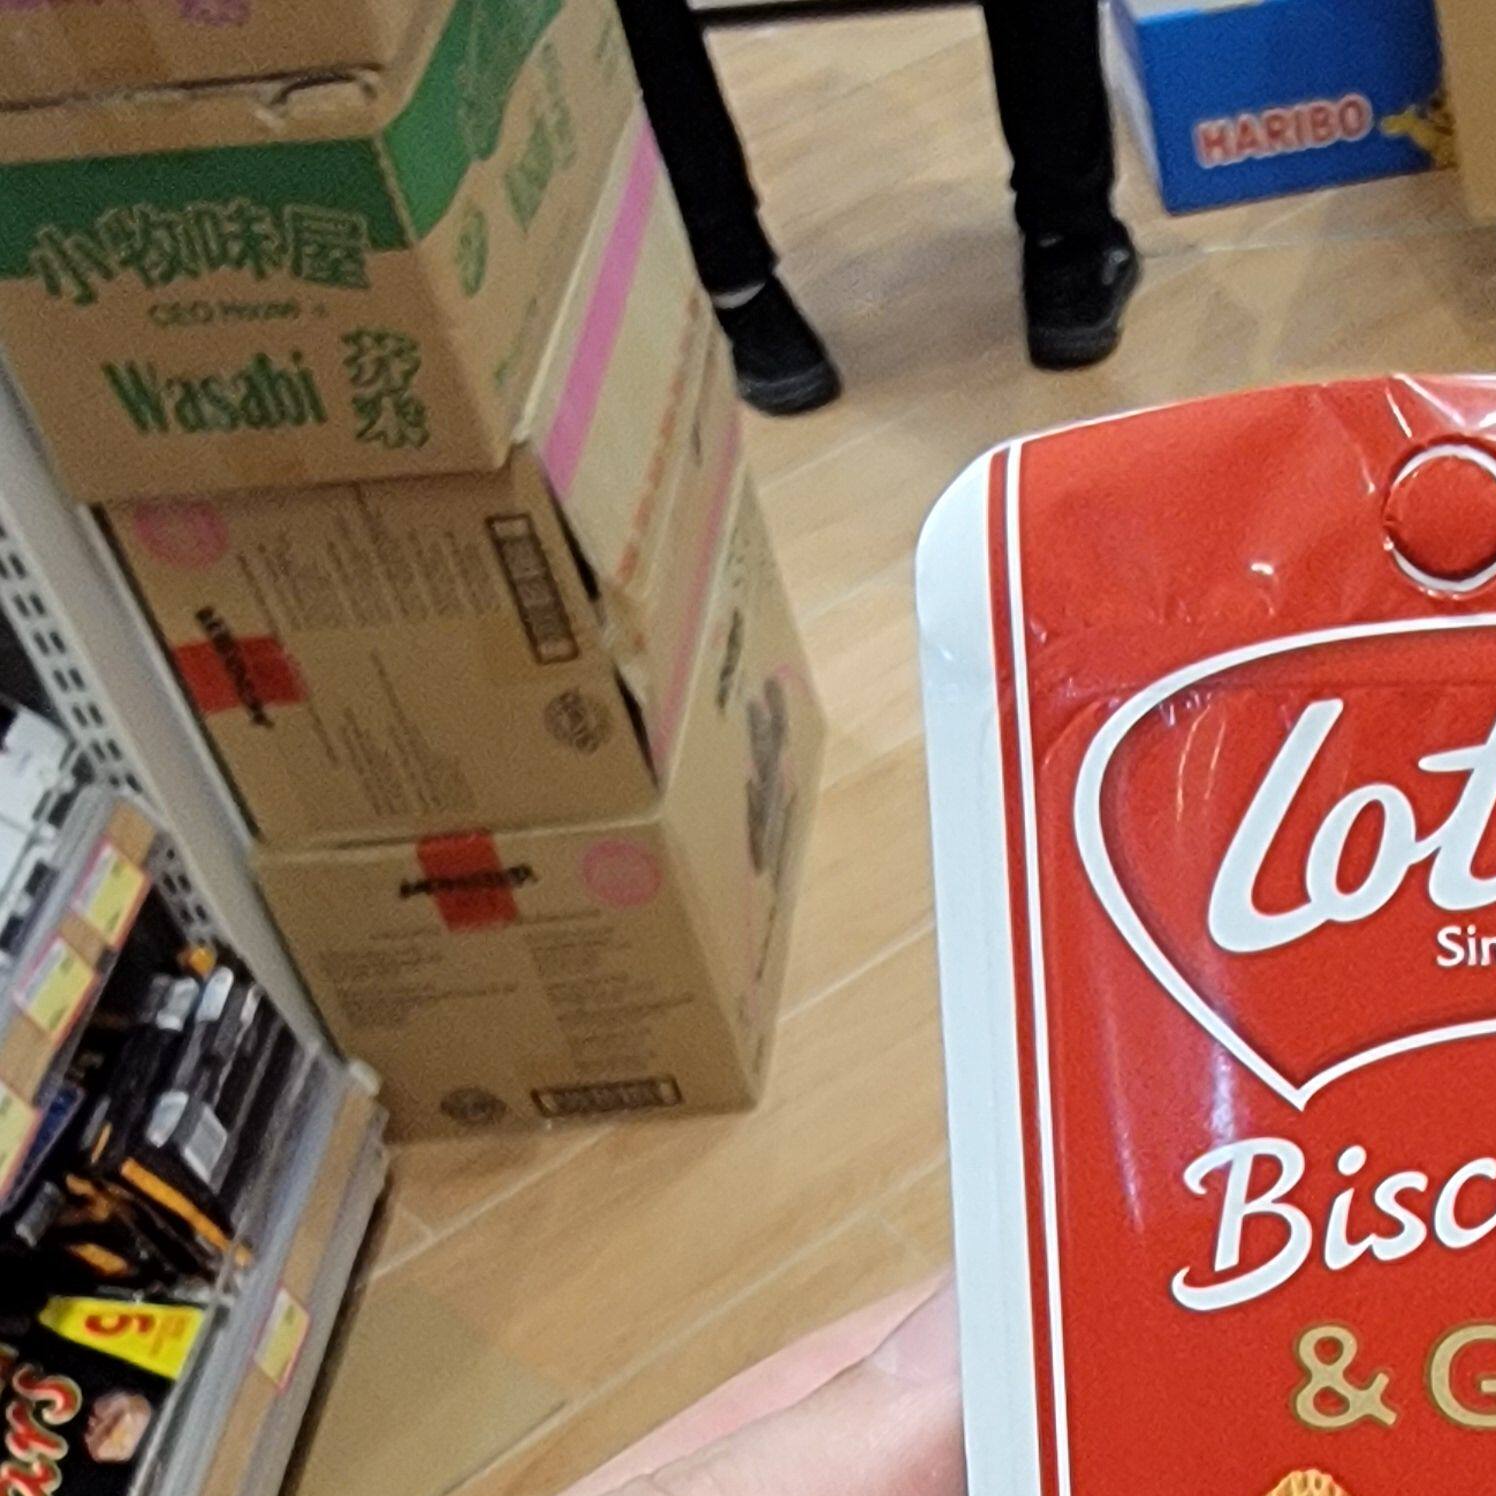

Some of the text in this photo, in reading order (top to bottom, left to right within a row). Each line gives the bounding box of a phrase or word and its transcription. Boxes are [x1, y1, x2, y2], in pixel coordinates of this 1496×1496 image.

[1192, 92, 1373, 170] HARIBO
[103, 351, 327, 433] Wasabi
[1296, 1325, 1397, 1429] &
